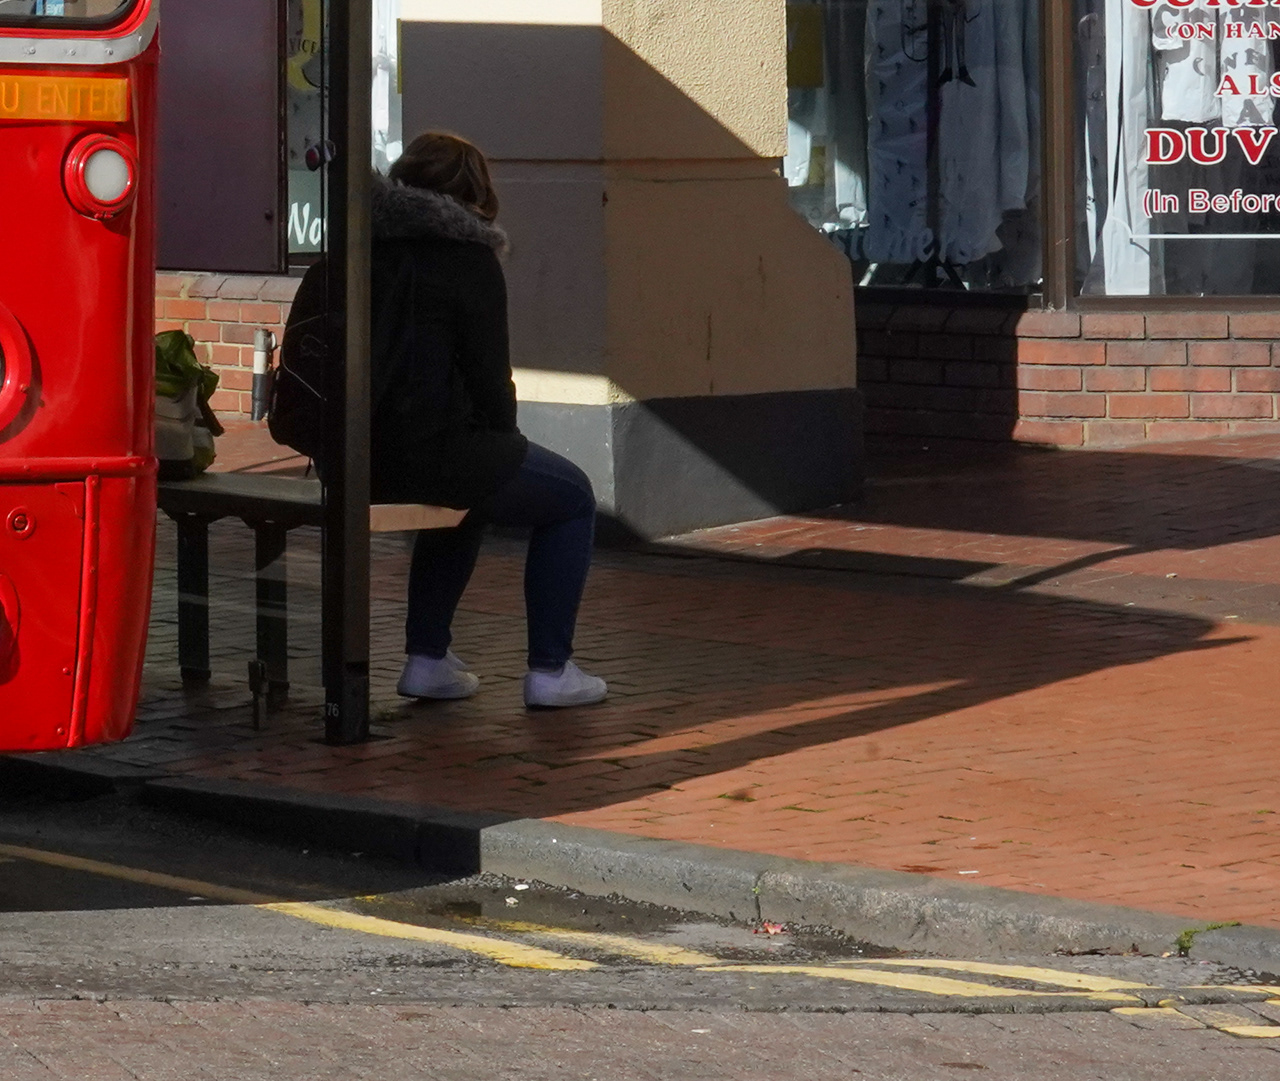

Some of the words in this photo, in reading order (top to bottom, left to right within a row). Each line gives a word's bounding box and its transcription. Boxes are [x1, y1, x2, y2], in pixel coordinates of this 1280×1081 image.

[38, 83, 123, 116] ENTER
[1144, 126, 1279, 166] DUV
[1143, 188, 1179, 218] (In
